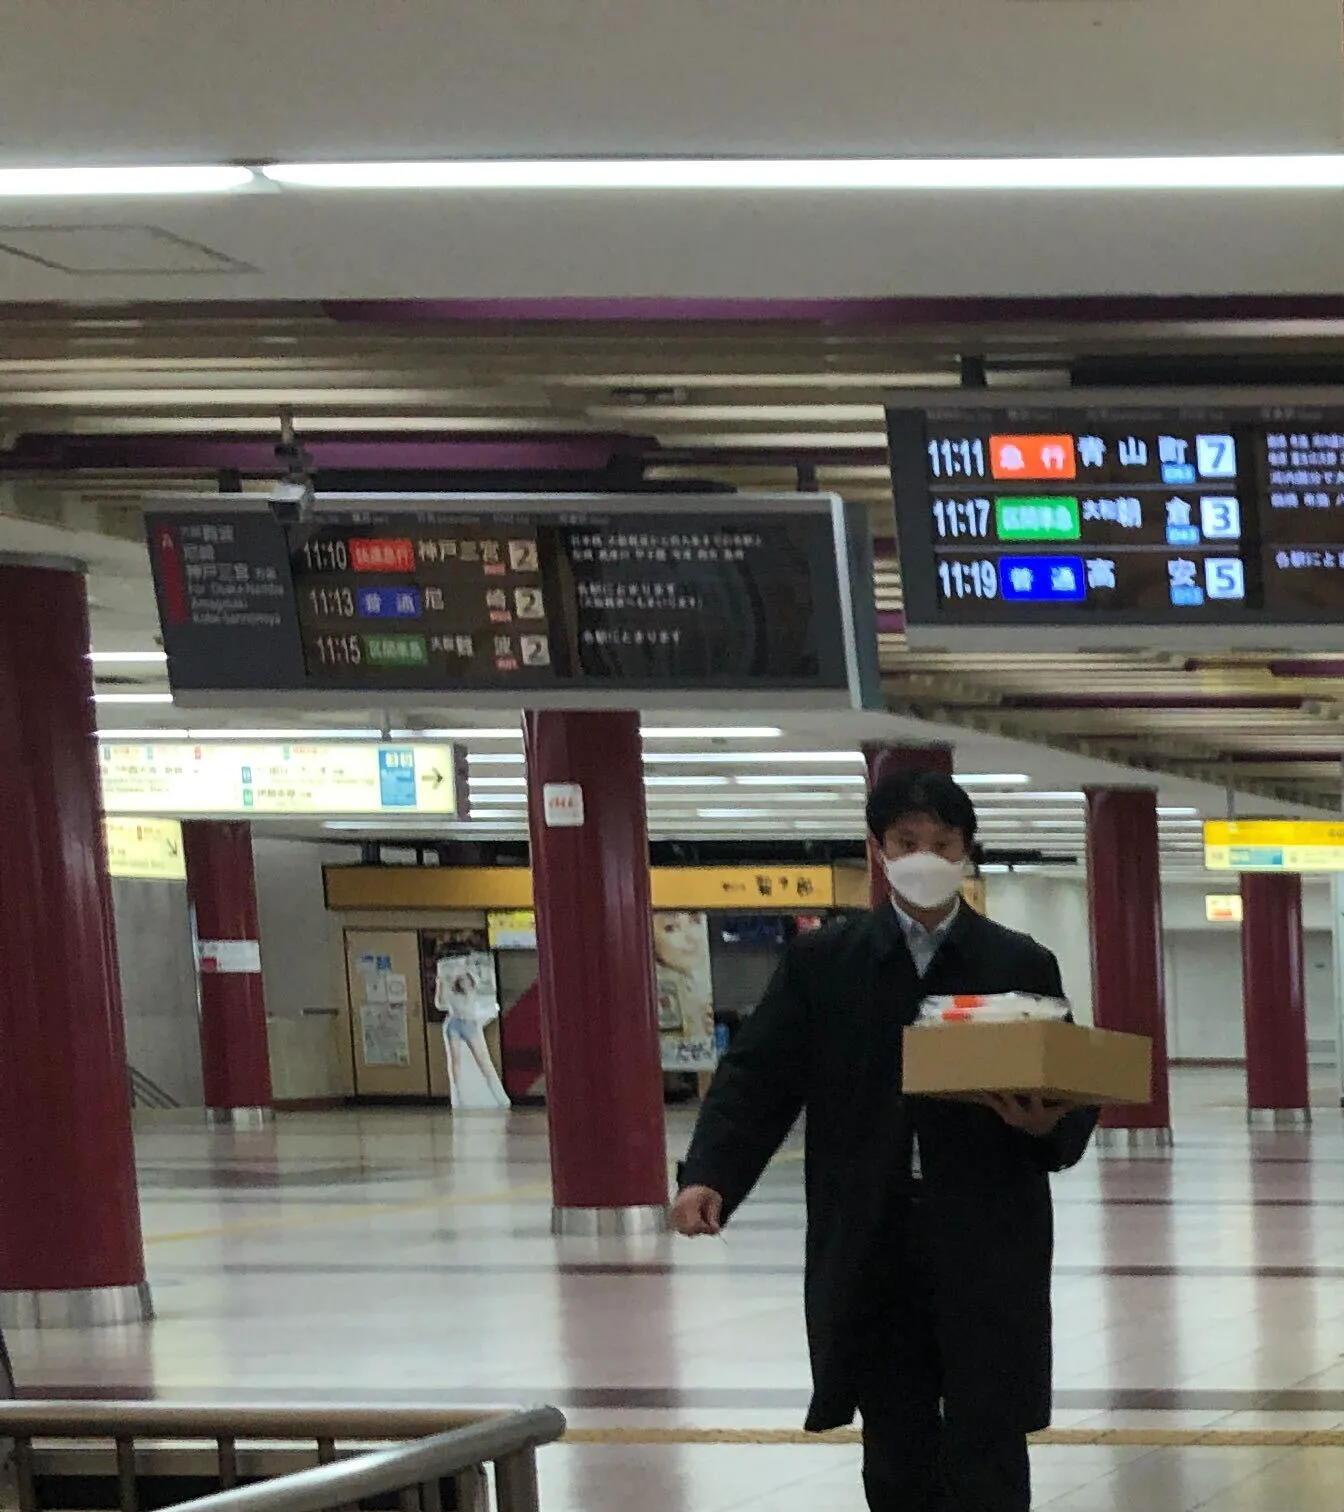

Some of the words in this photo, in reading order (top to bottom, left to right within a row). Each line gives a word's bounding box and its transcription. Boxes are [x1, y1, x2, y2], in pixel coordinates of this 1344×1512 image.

[928, 438, 985, 477] 11:11
[933, 498, 990, 538] 11:17
[304, 540, 347, 571] 11:10
[939, 559, 997, 598] 11:19
[310, 589, 354, 617] 11:13
[317, 636, 361, 664] 11:15
